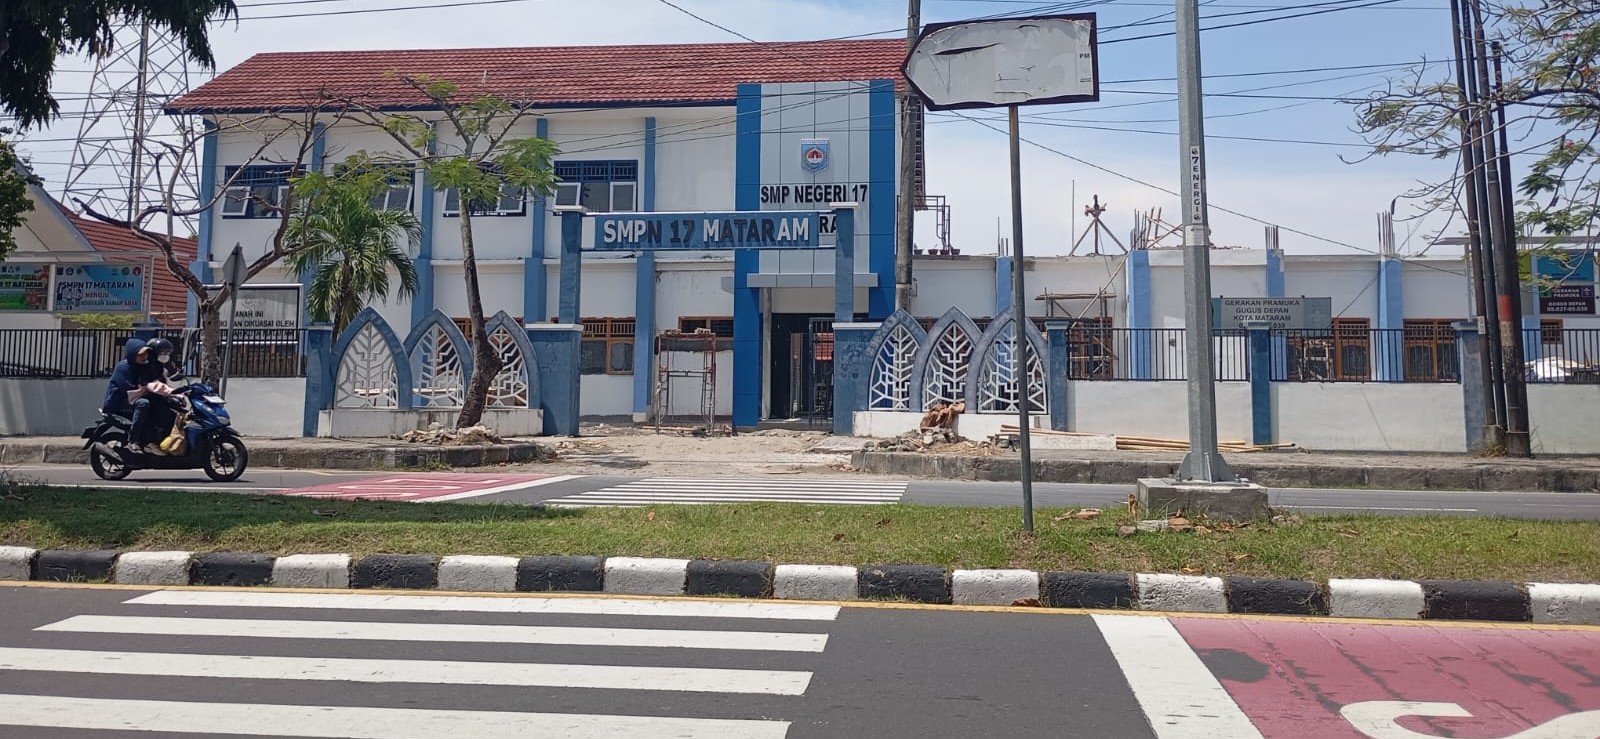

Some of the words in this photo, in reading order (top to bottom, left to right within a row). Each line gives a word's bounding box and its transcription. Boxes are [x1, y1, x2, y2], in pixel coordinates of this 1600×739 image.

[761, 185, 790, 204] SMP
[795, 184, 847, 203] NEGERI
[852, 184, 868, 203] 17
[603, 219, 662, 244] SMPN
[670, 219, 696, 243] 17
[703, 217, 809, 243] MATARAM
[94, 281, 134, 289] MATARAM
